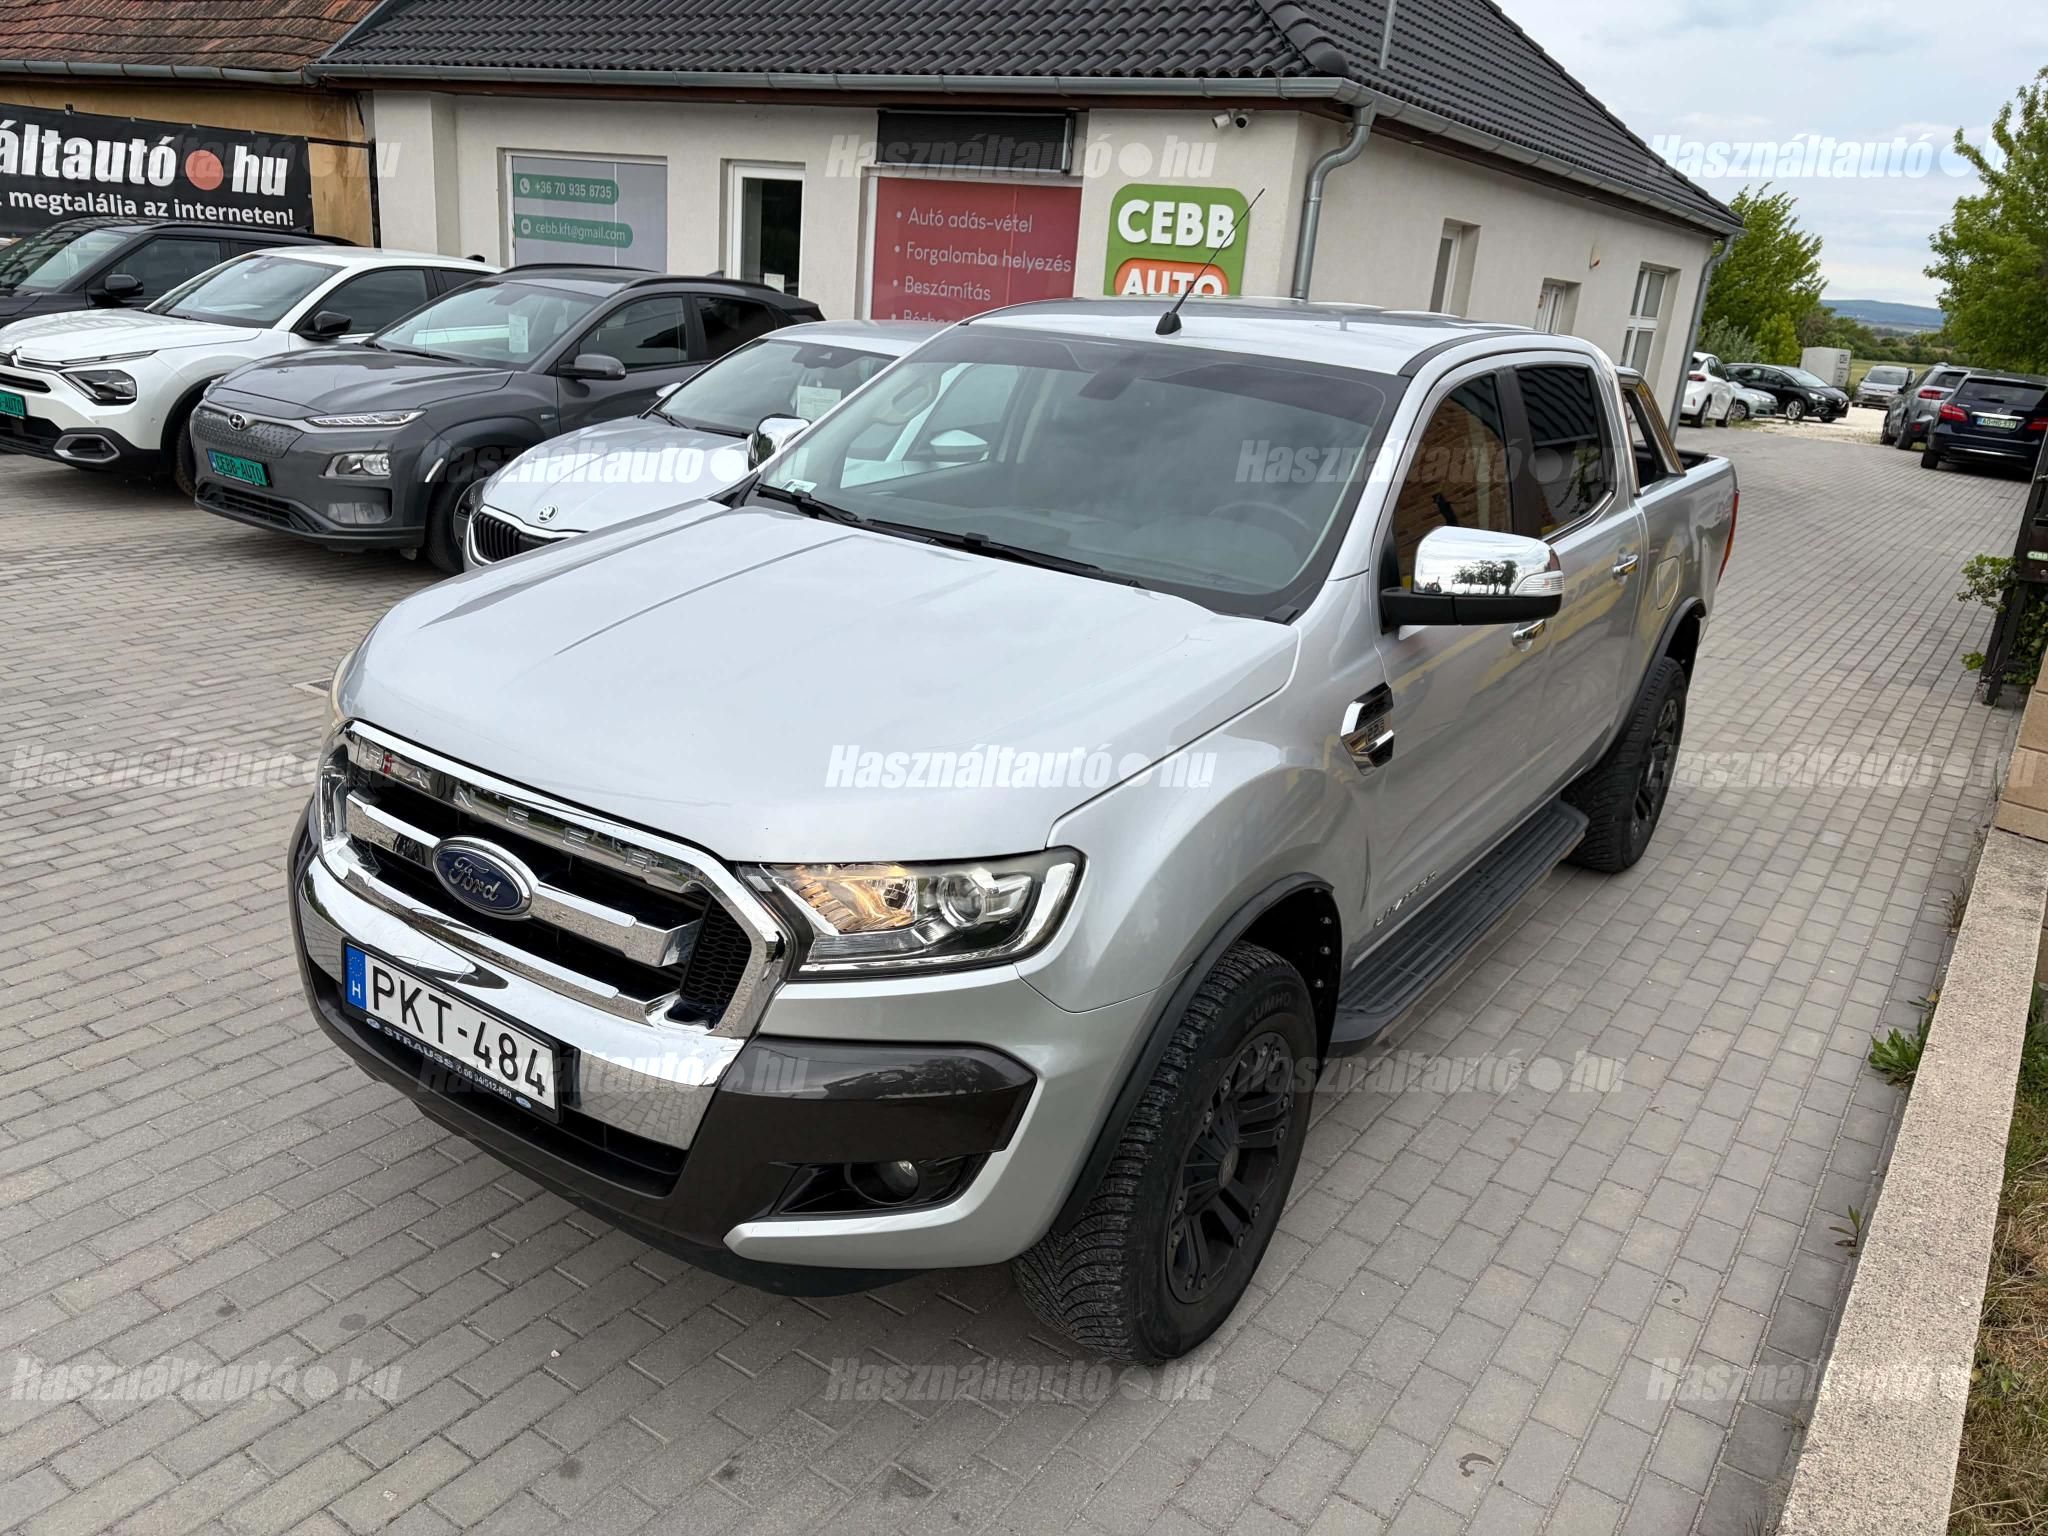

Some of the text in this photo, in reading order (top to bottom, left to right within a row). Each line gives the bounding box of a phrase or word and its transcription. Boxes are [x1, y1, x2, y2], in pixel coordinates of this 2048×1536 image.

[555, 182, 566, 195] 70
[569, 183, 586, 197] 935
[589, 185, 612, 199] 8735
[143, 200, 169, 217] az
[174, 198, 294, 226] interneten!
[907, 207, 1033, 233] Autó adás-vétel
[1117, 199, 1236, 249] CEBB
[535, 221, 626, 241] cebb.kft@gmail.com
[906, 241, 1072, 274] Forgalomba helyezés
[903, 276, 992, 302] Beszámítás
[1120, 268, 1222, 297] AUTO
[215, 454, 264, 482] CEBB-AUTO
[448, 856, 500, 900] Ford
[352, 980, 361, 999] H
[372, 965, 545, 1098] PKT-484
[384, 1026, 454, 1069] STRAUSS
